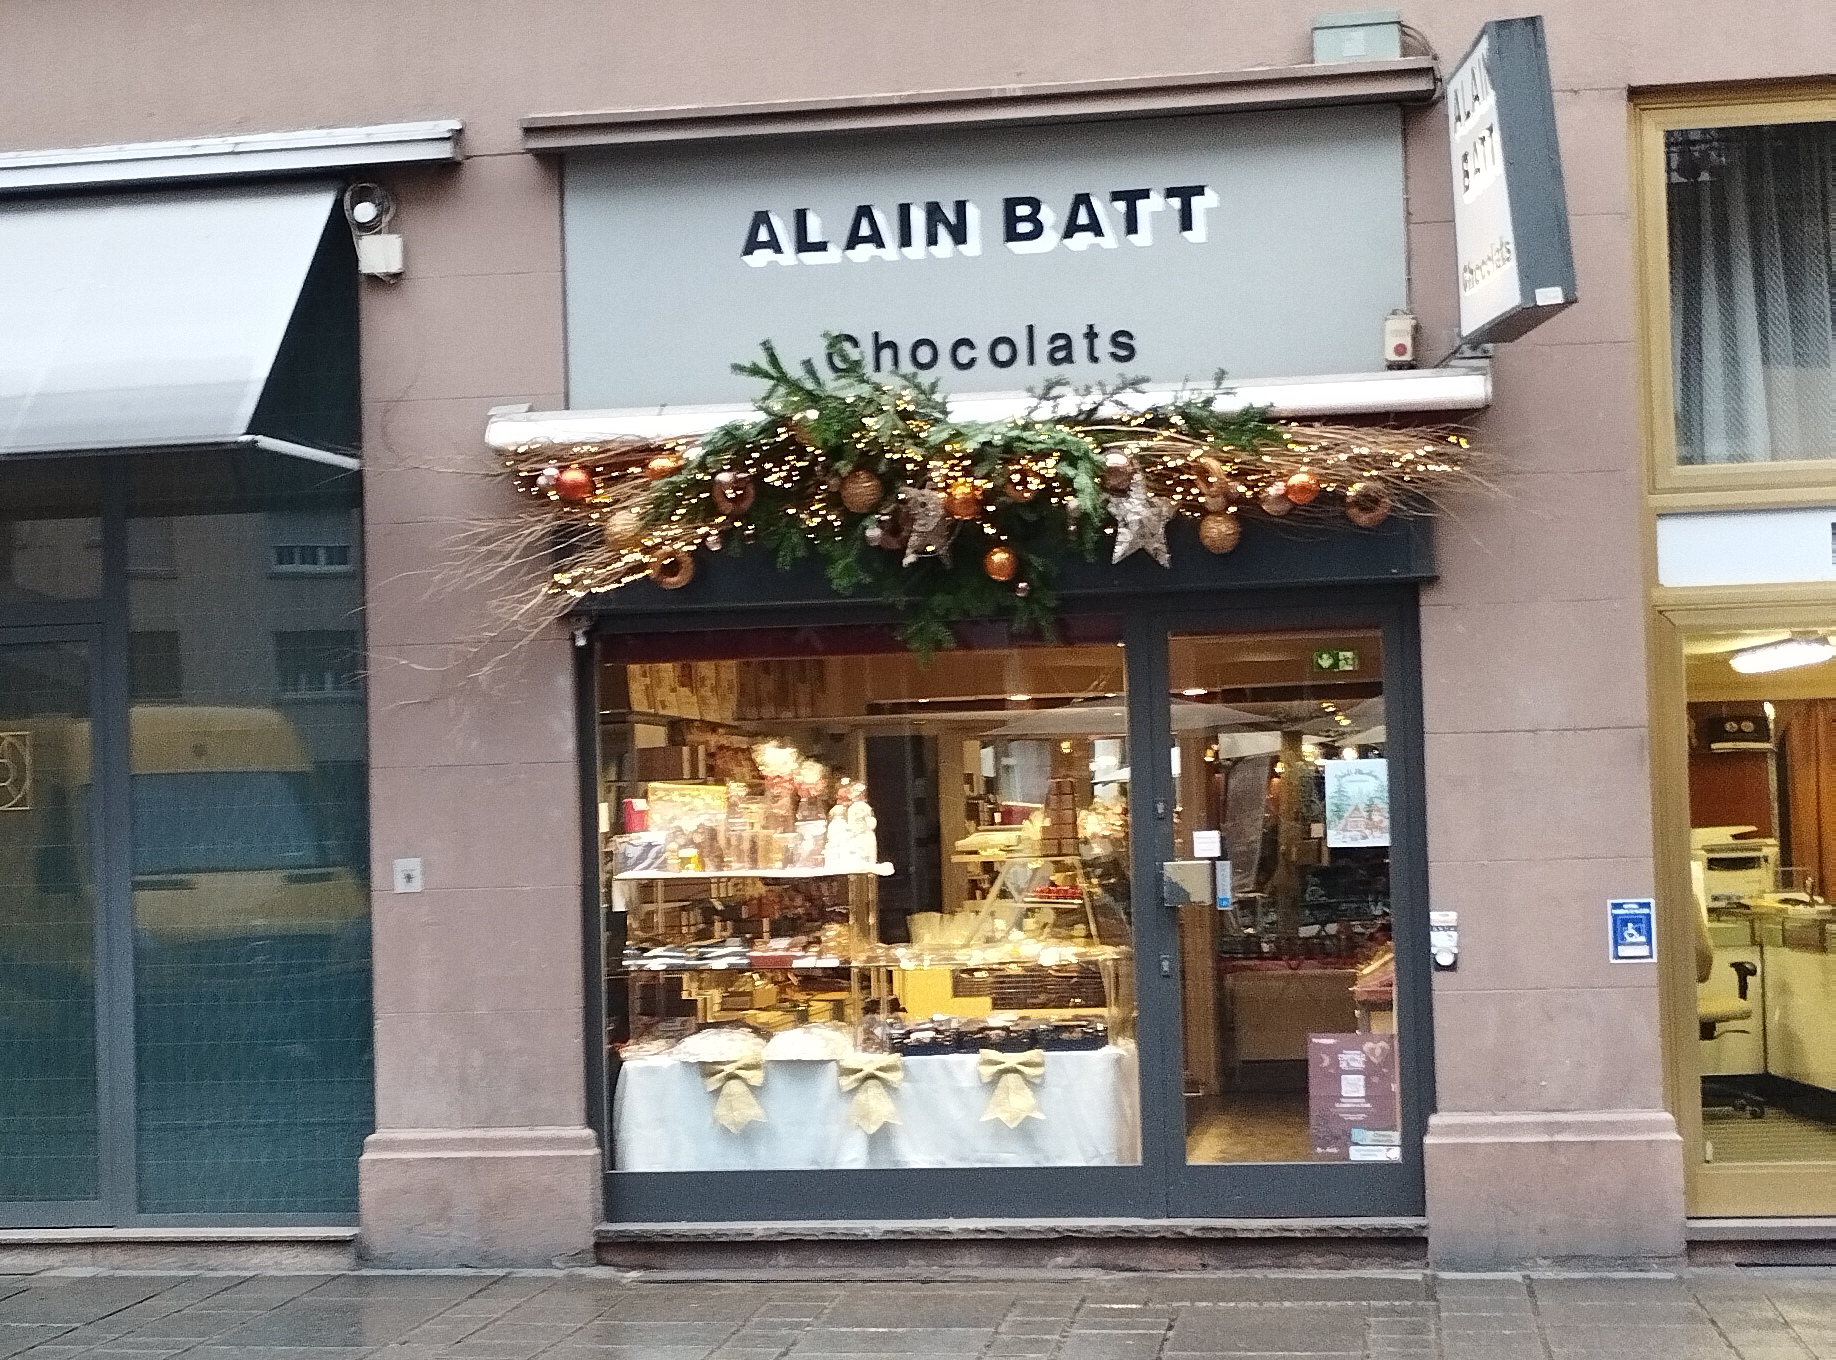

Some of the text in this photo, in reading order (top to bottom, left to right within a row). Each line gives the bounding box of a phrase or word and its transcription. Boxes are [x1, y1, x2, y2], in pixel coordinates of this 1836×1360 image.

[740, 185, 1220, 268] ALAIN BATT
[826, 323, 1137, 373] Chocolats
